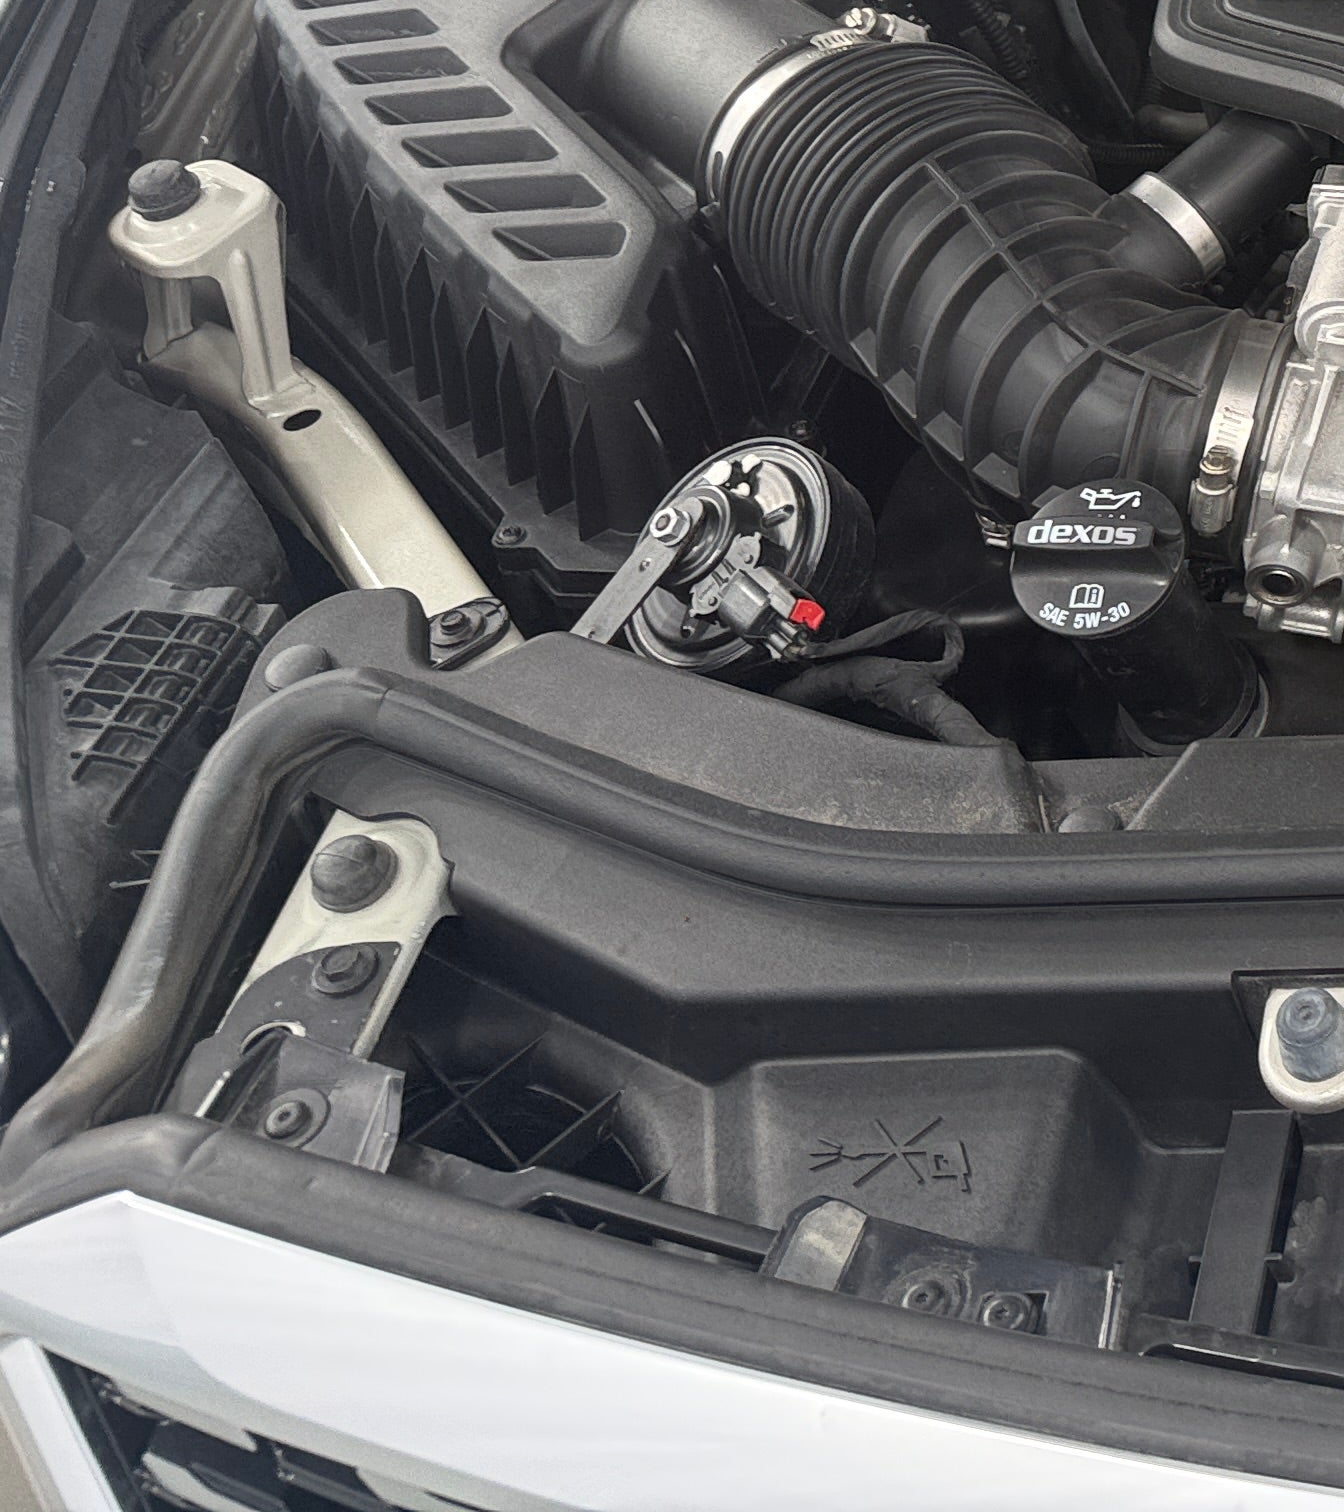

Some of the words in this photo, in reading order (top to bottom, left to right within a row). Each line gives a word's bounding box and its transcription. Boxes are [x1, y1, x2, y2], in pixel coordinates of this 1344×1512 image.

[1027, 519, 1138, 545] dexos
[1039, 602, 1070, 627] SAE
[1073, 602, 1131, 629] 5W-30
